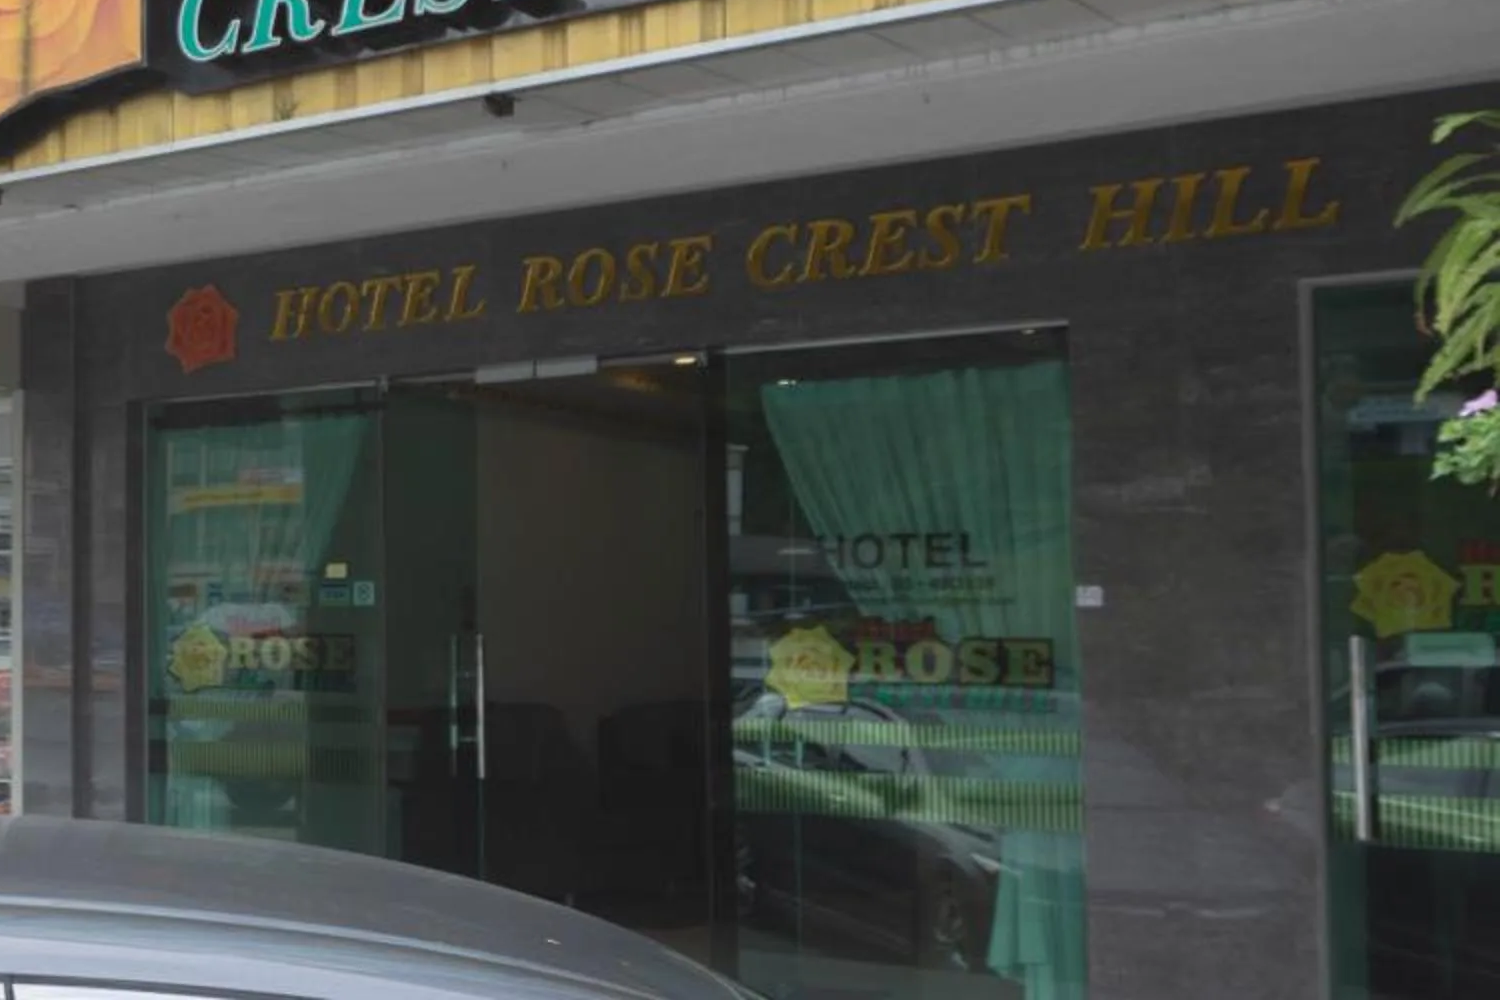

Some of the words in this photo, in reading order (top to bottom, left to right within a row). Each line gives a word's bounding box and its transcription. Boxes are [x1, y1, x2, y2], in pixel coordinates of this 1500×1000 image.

[269, 264, 487, 343] HOTEL
[515, 235, 717, 315] ROSE
[746, 195, 1032, 291] CREST
[1077, 157, 1342, 252] HILL
[818, 533, 988, 570] HOTEL
[228, 635, 354, 671] ROSE
[856, 639, 1052, 684] ROSE
